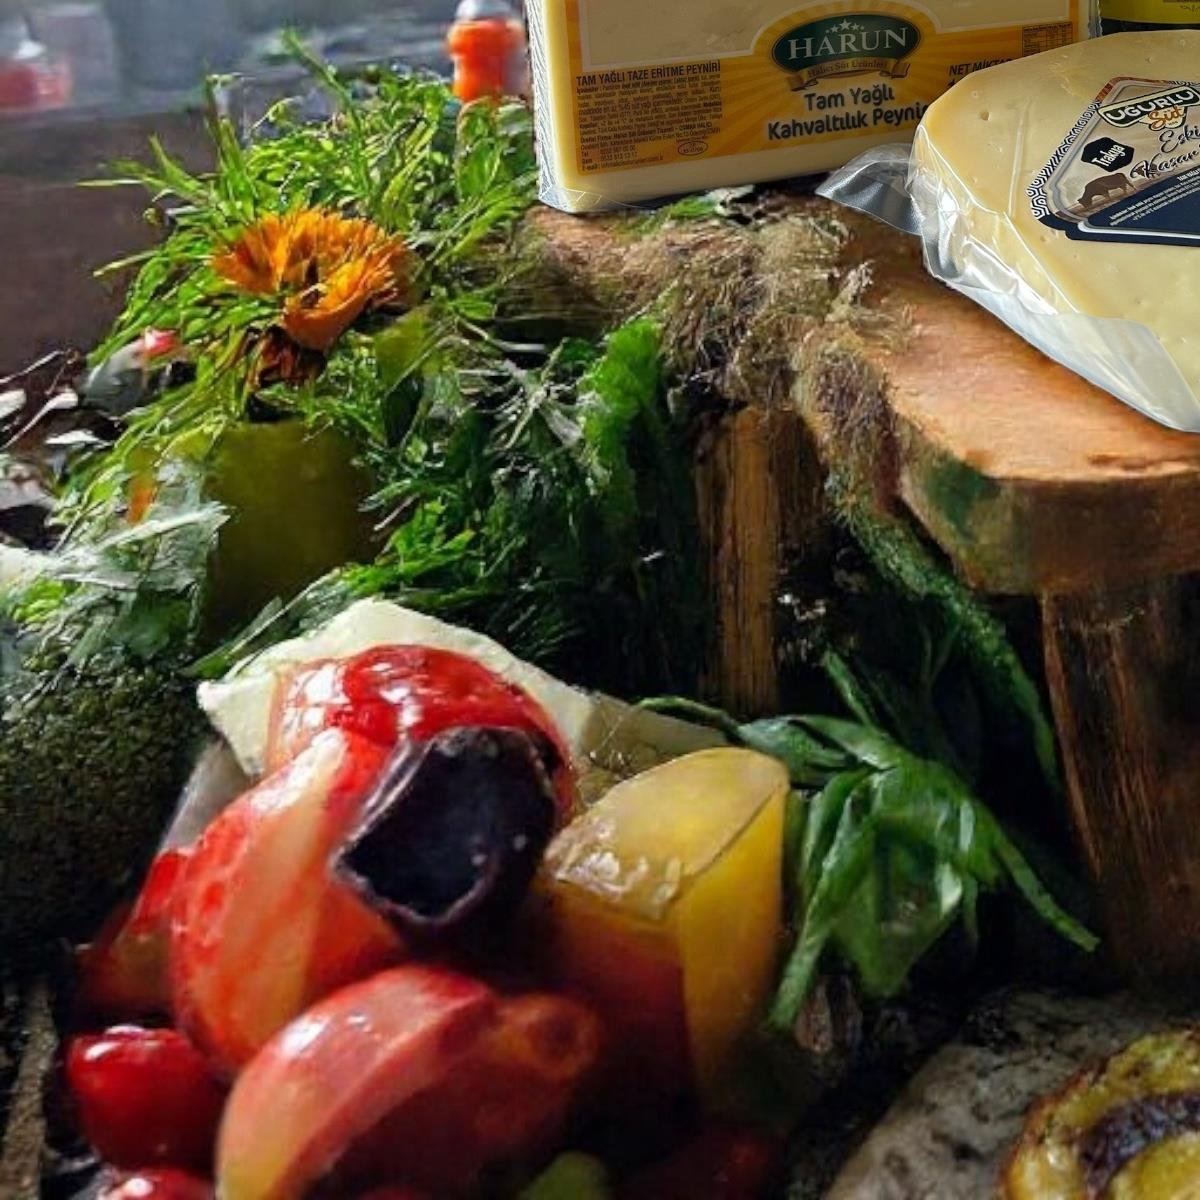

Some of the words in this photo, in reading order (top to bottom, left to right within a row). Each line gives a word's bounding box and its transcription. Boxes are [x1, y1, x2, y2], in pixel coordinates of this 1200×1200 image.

[788, 27, 907, 60] HARUN
[576, 75, 596, 86] TAM
[599, 69, 625, 84] YAĞLI
[627, 70, 649, 82] TAZE
[651, 66, 684, 79] ERİTME
[949, 63, 971, 76] NET
[804, 92, 845, 111] Tam
[849, 83, 895, 106] Yağlı
[768, 110, 868, 140] Kahvaltılık
[1091, 144, 1125, 167] Trakya
